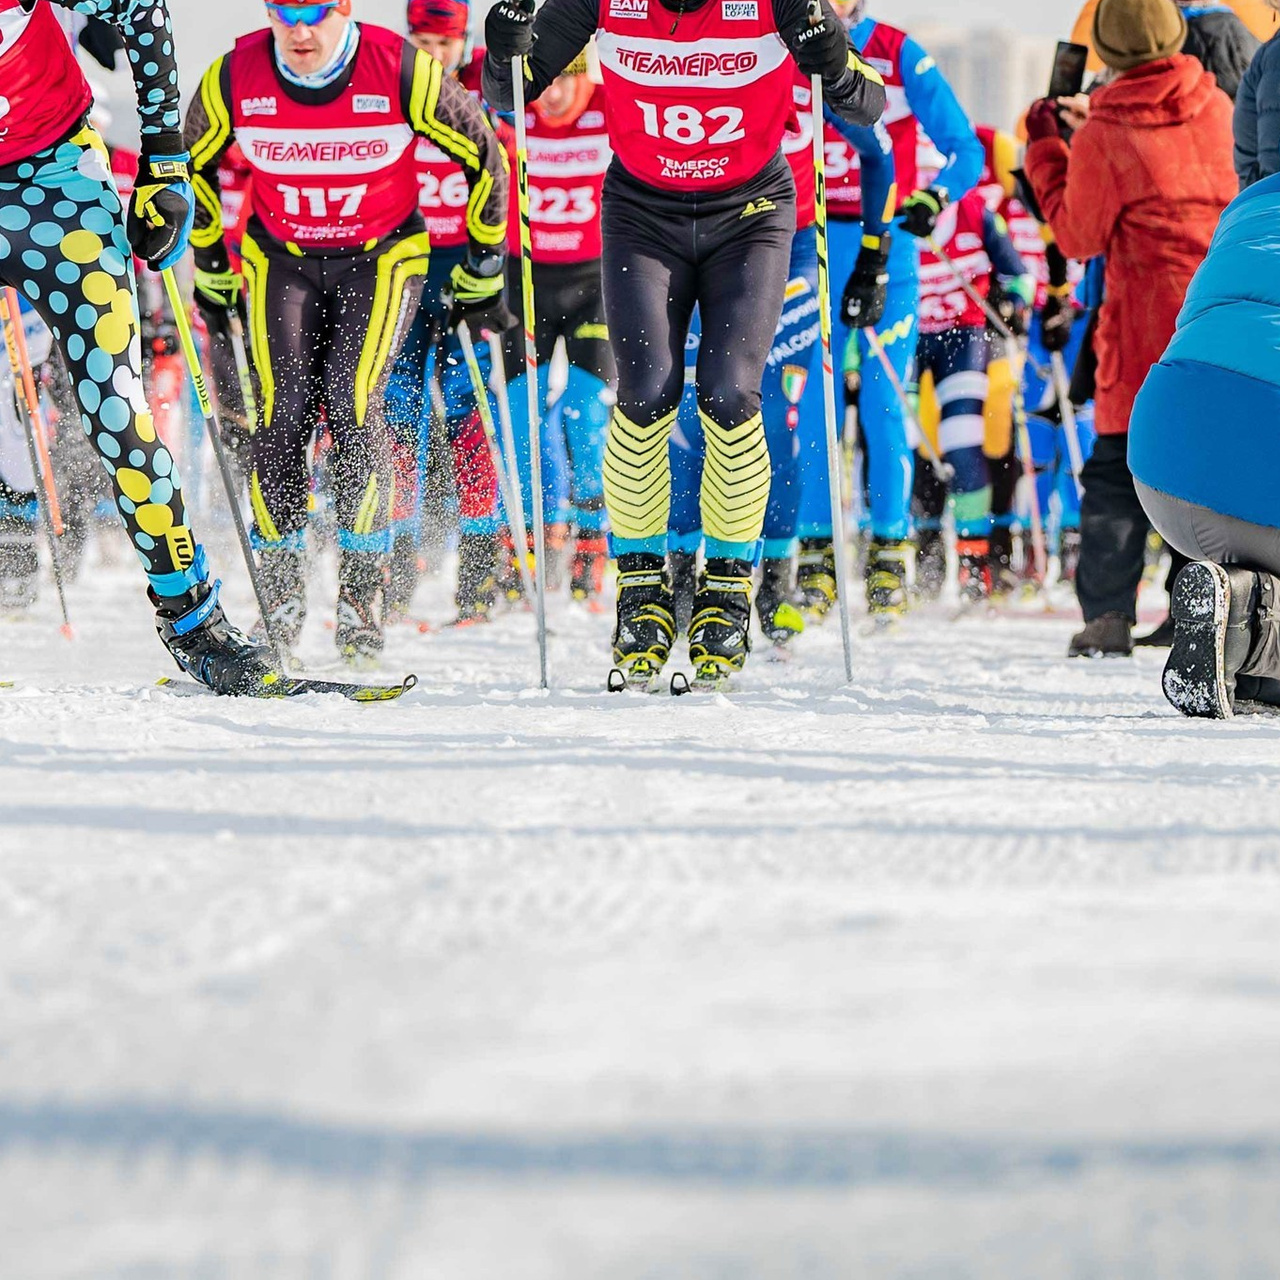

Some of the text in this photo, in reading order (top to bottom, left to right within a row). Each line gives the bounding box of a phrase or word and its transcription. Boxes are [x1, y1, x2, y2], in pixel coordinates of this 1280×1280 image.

[798, 23, 826, 42] MOAX
[616, 47, 758, 77] ТЕМЕРСО
[634, 99, 746, 145] 182
[252, 140, 388, 162] ТЕМЕРСО
[660, 166, 725, 179] АНГАРА
[277, 183, 369, 217] 117
[195, 373, 211, 408] HIDE
